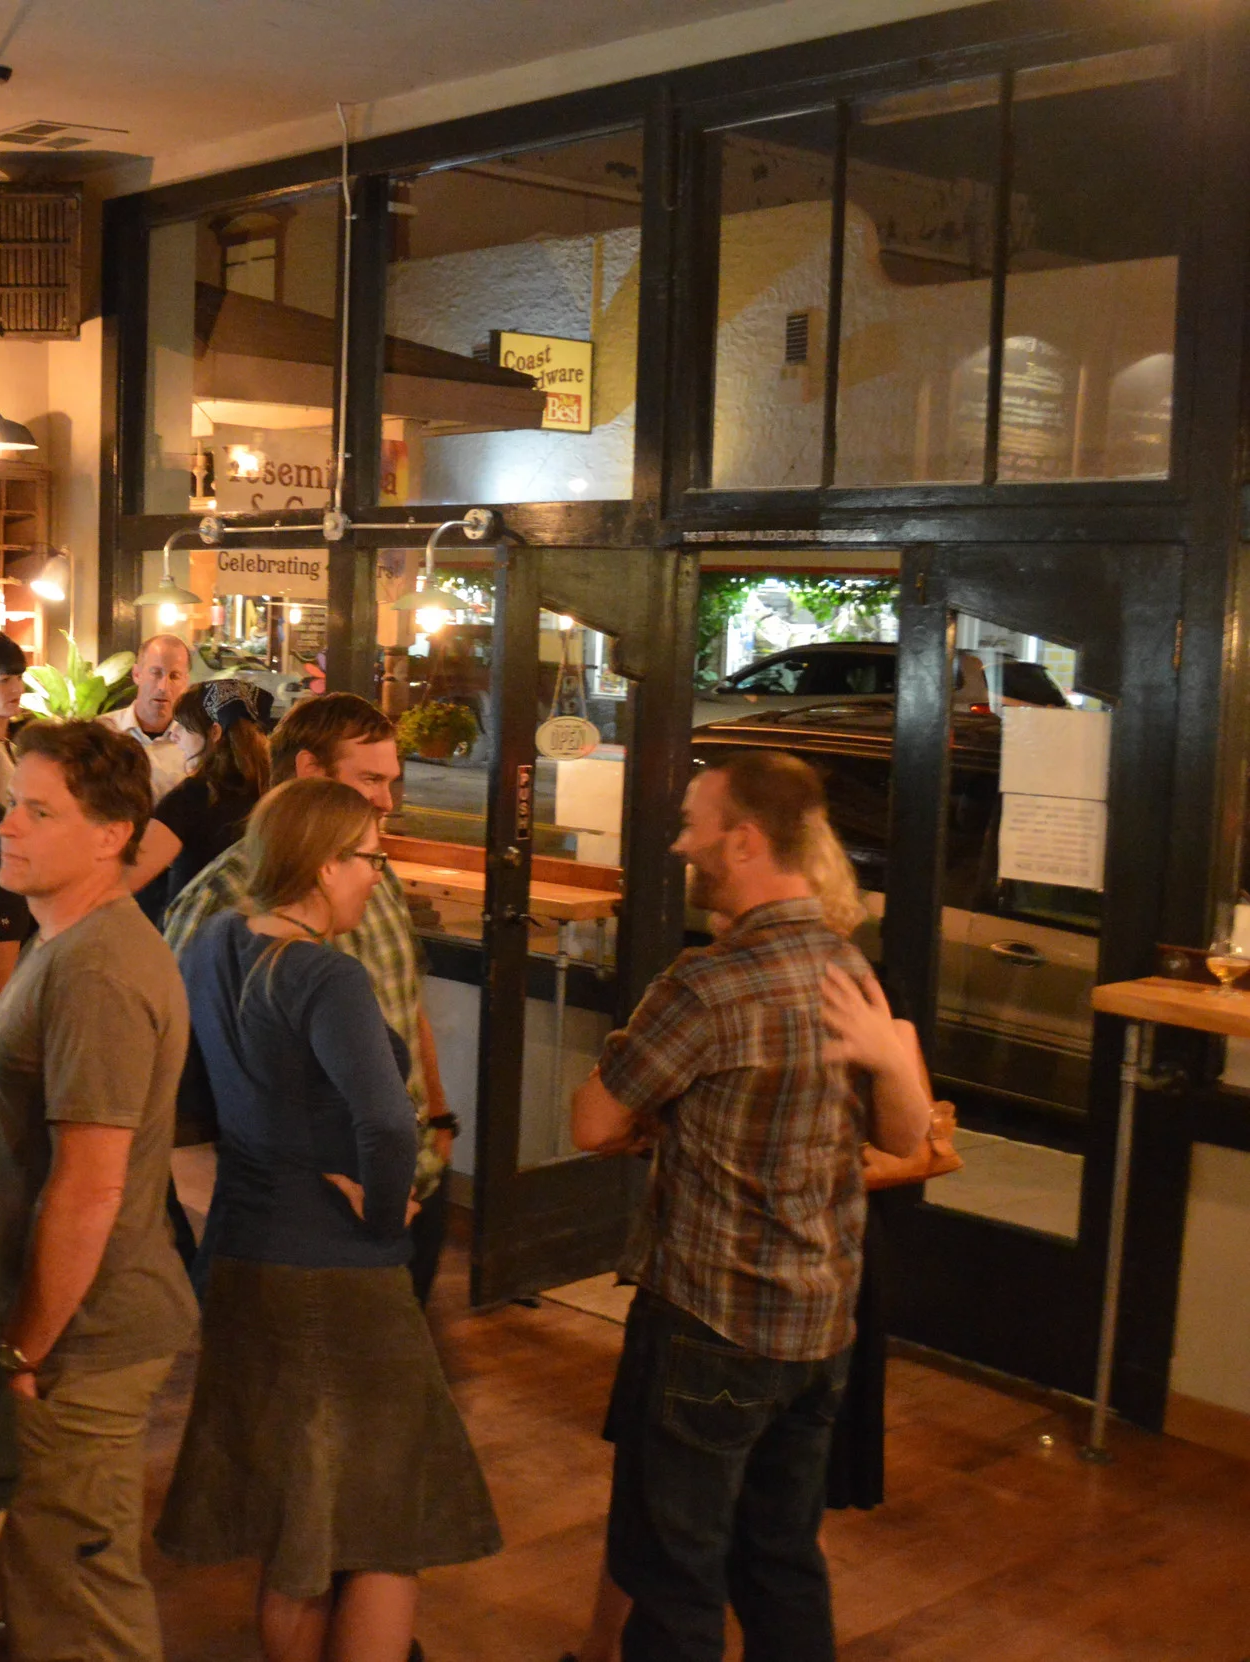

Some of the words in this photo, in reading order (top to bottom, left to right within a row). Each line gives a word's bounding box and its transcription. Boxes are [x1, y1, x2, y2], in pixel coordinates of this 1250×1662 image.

[503, 345, 551, 370] Coast
[536, 367, 584, 389] dware
[546, 397, 580, 423] Best
[217, 551, 321, 581] Celebrating
